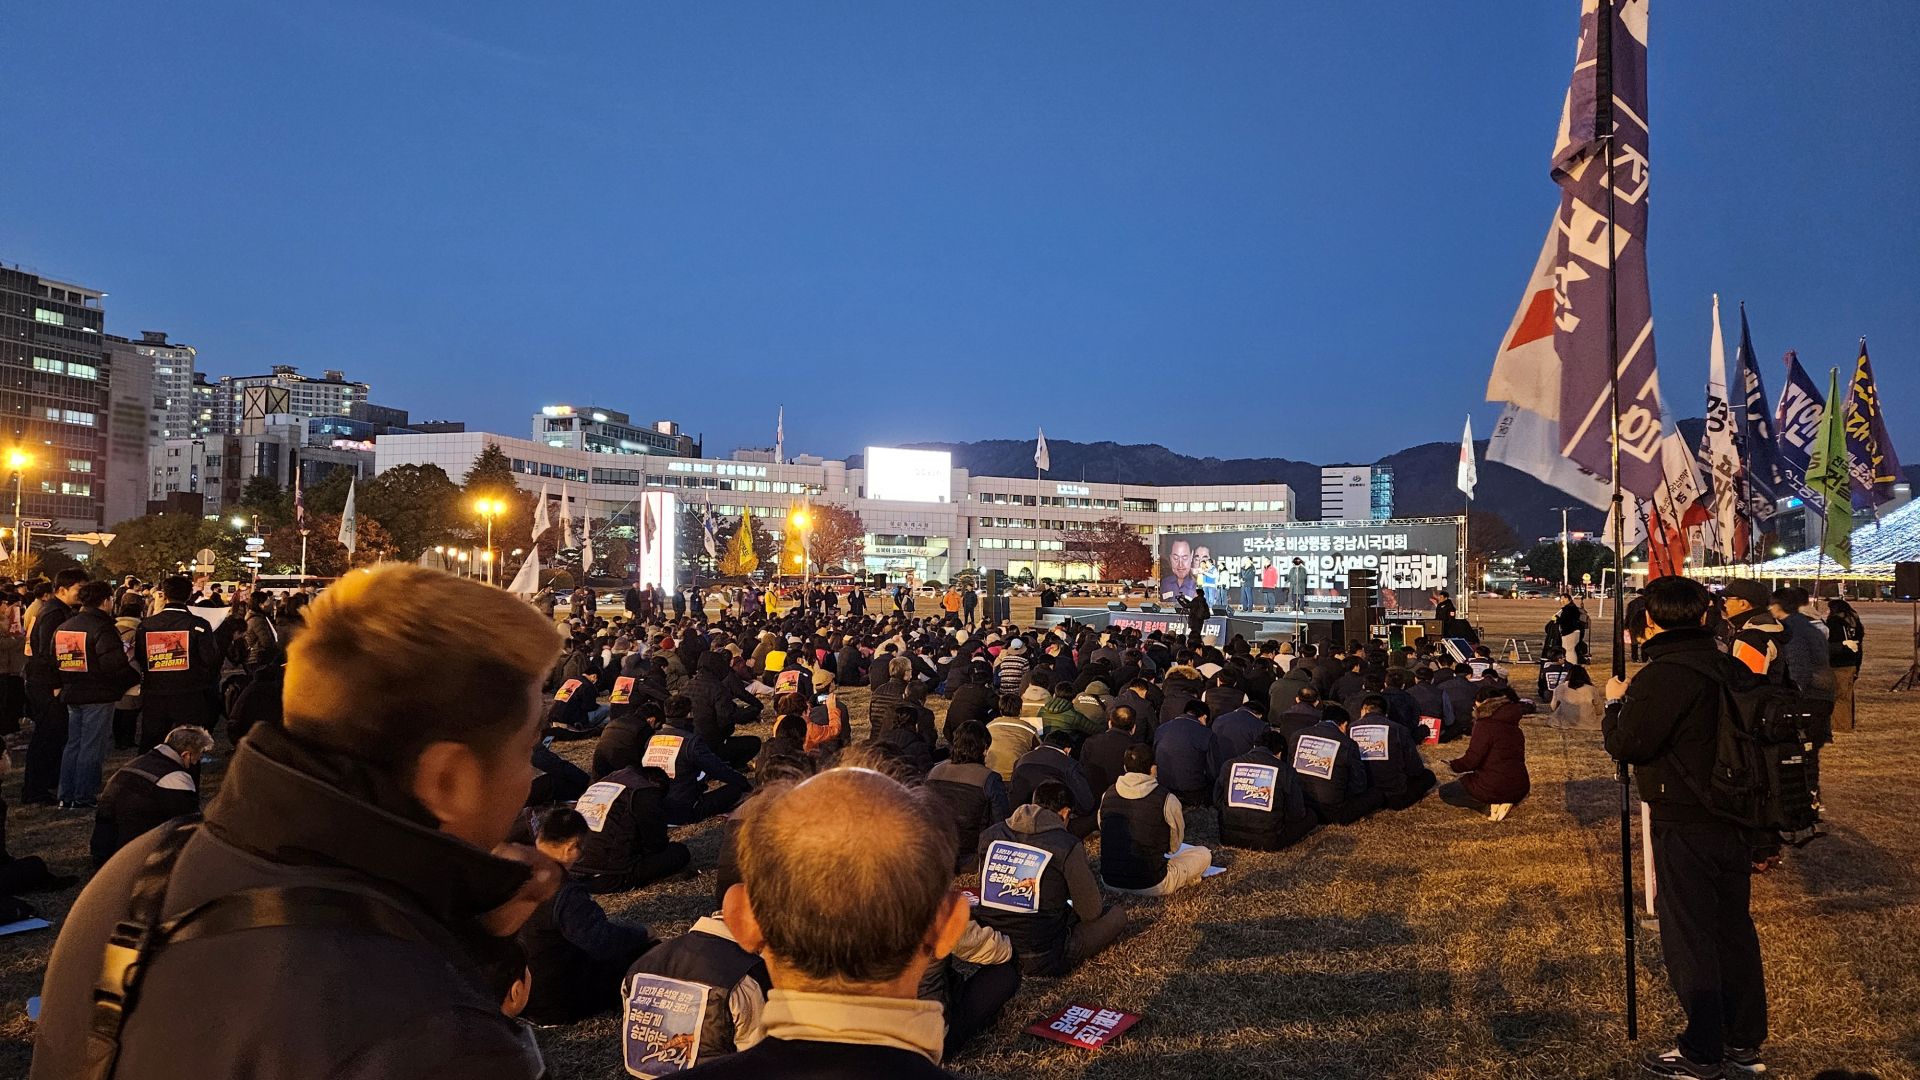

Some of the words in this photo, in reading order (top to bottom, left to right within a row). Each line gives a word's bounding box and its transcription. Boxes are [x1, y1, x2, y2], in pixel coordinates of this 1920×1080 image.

[1243, 536, 1286, 552] 민주수호
[1286, 535, 1332, 552] 비상행동
[1332, 534, 1408, 551] 경남시국대회
[1380, 554, 1448, 590] 체포하라!
[630, 1008, 664, 1028] 금속답게
[630, 1024, 668, 1046] 승리하는
